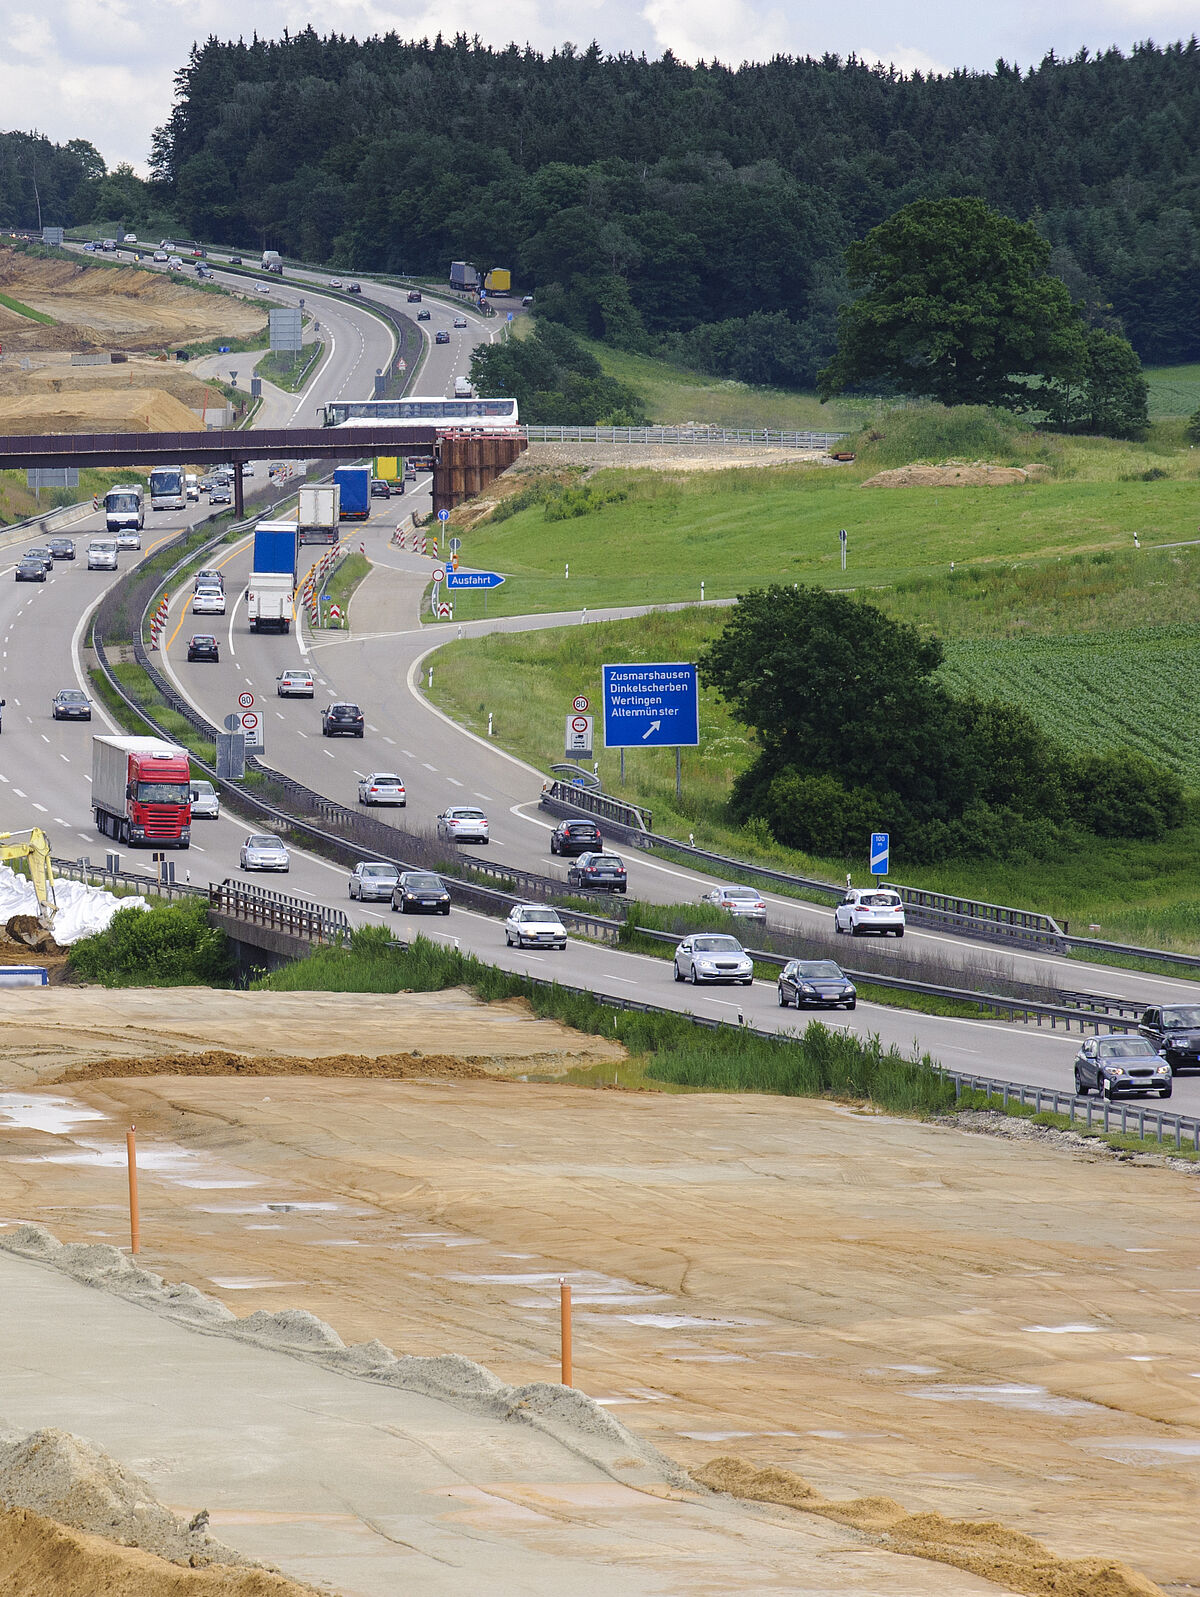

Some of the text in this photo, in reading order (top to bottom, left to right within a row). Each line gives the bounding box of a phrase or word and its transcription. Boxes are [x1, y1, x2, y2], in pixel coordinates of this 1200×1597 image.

[451, 576, 491, 585] Ausfahrt
[610, 670, 691, 681] Zusmarshausen
[610, 682, 688, 693] Dinkelscherben
[241, 696, 251, 704] 80
[576, 700, 586, 708] 80
[611, 695, 662, 707] Wertingen
